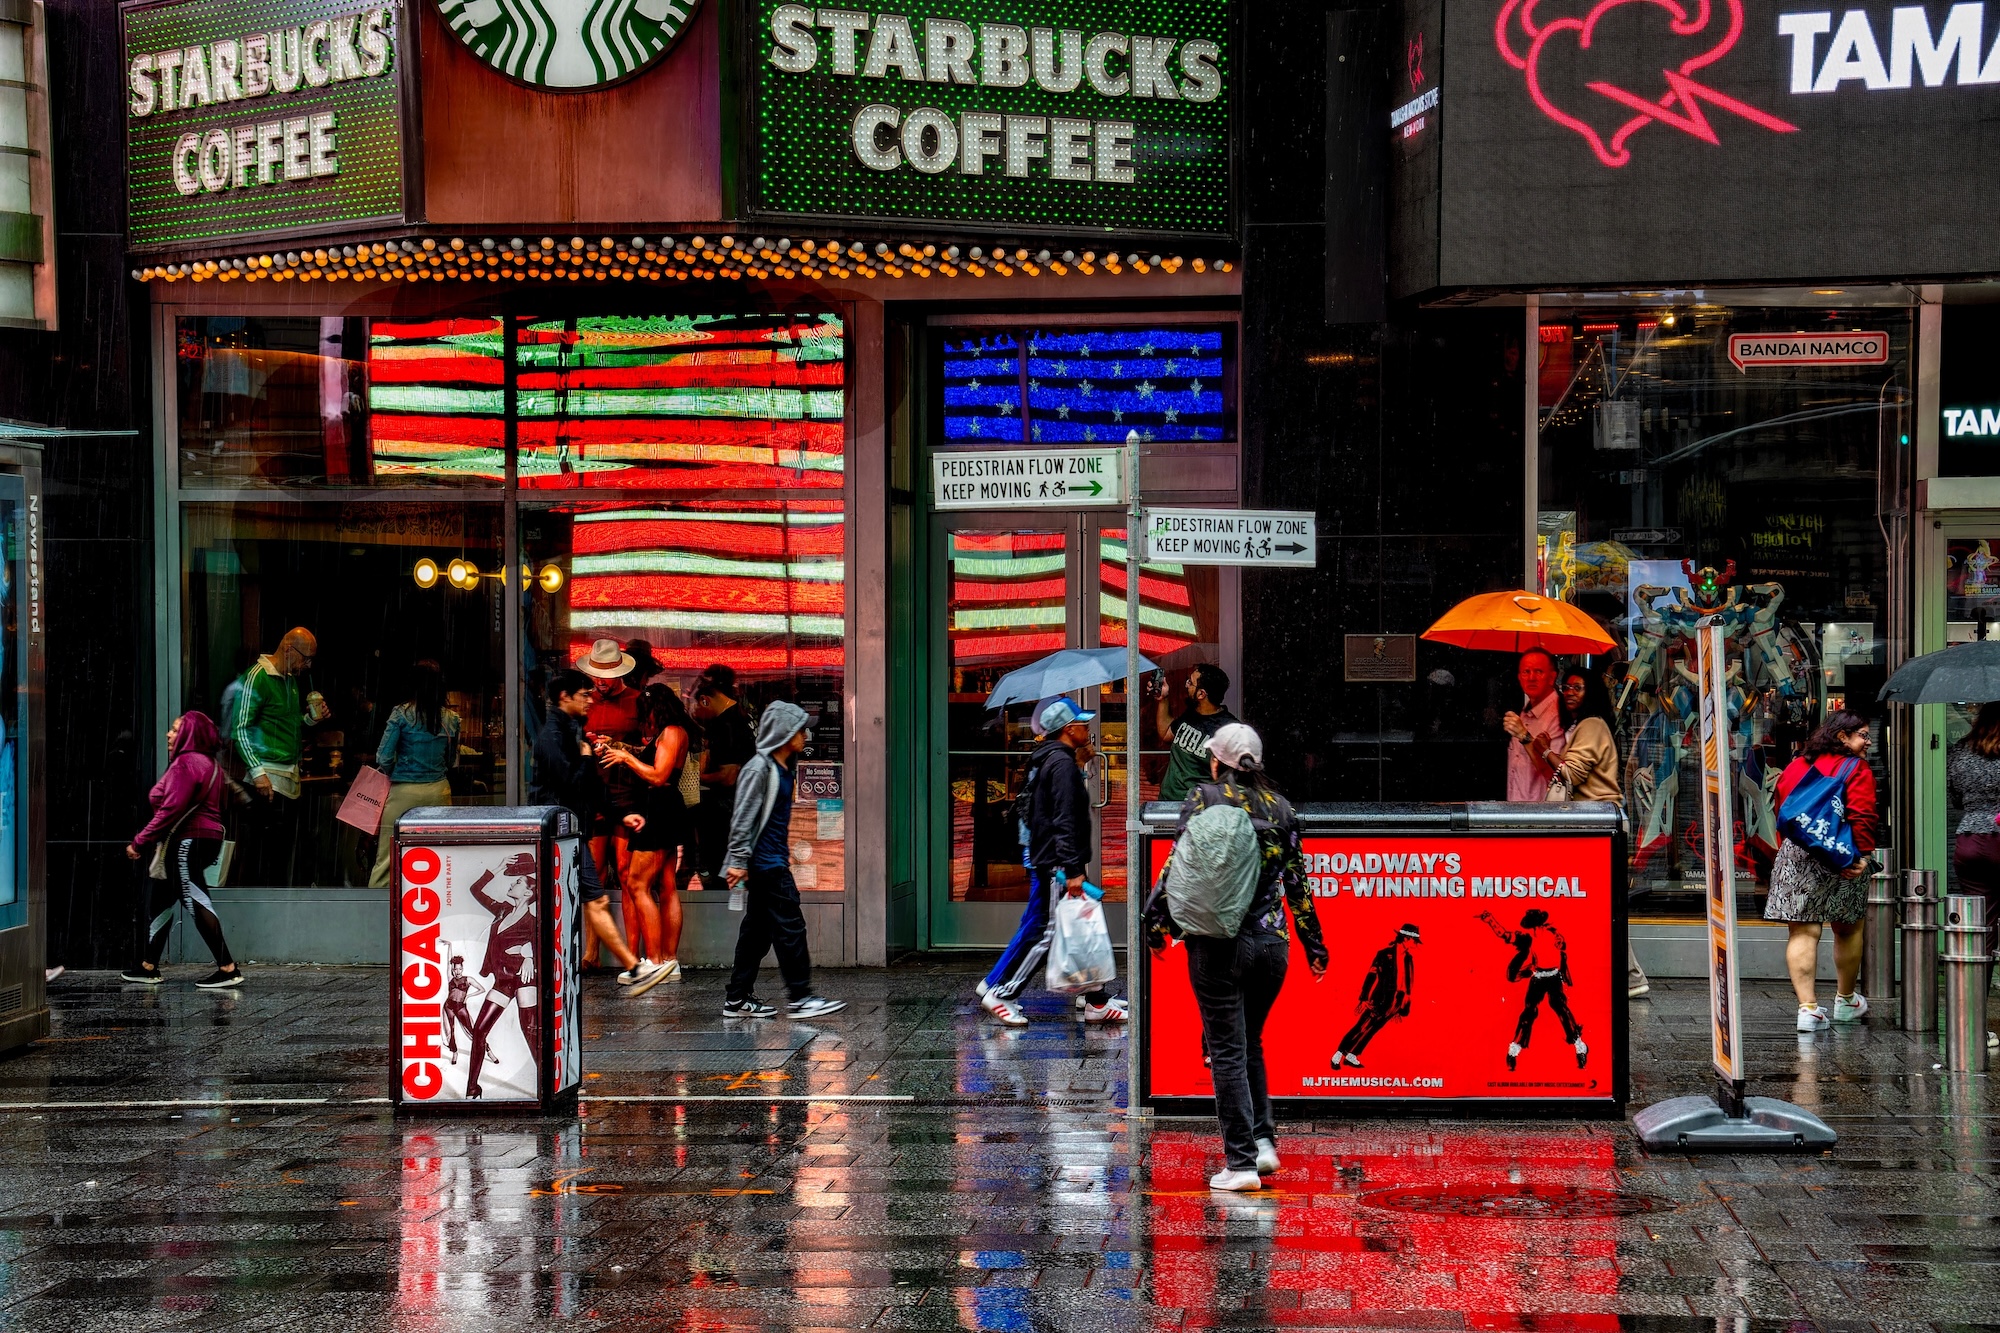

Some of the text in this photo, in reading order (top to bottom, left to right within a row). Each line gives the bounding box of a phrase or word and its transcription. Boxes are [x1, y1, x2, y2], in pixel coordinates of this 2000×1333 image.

[131, 8, 389, 117] STARBUCKS
[771, 4, 1221, 102] STARBUCKS
[1779, 2, 2000, 94] TAM
[173, 111, 338, 196] COFFEE
[852, 104, 1135, 184] COFFEE
[1740, 341, 1878, 356] BANDAI NAMCO
[942, 457, 1103, 477] PEDESTRIAN FLOW ZONE
[943, 482, 1031, 500] KEEP MOVING
[1156, 517, 1233, 533] PEDESTRIAN
[1238, 519, 1272, 534] FLOW
[1276, 520, 1308, 535] ZONE
[29, 495, 40, 633] Newsstand
[1156, 538, 1241, 554] KEEP MOVING
[1173, 722, 1210, 759] CUBA
[814, 768, 835, 776] Smoking
[1472, 877, 1587, 898] MUSICAL
[402, 847, 443, 1100] CHICAGO
[553, 843, 563, 1094] CHICAGO
[1302, 1076, 1444, 1088] MJTHEMUSICAL.COM
